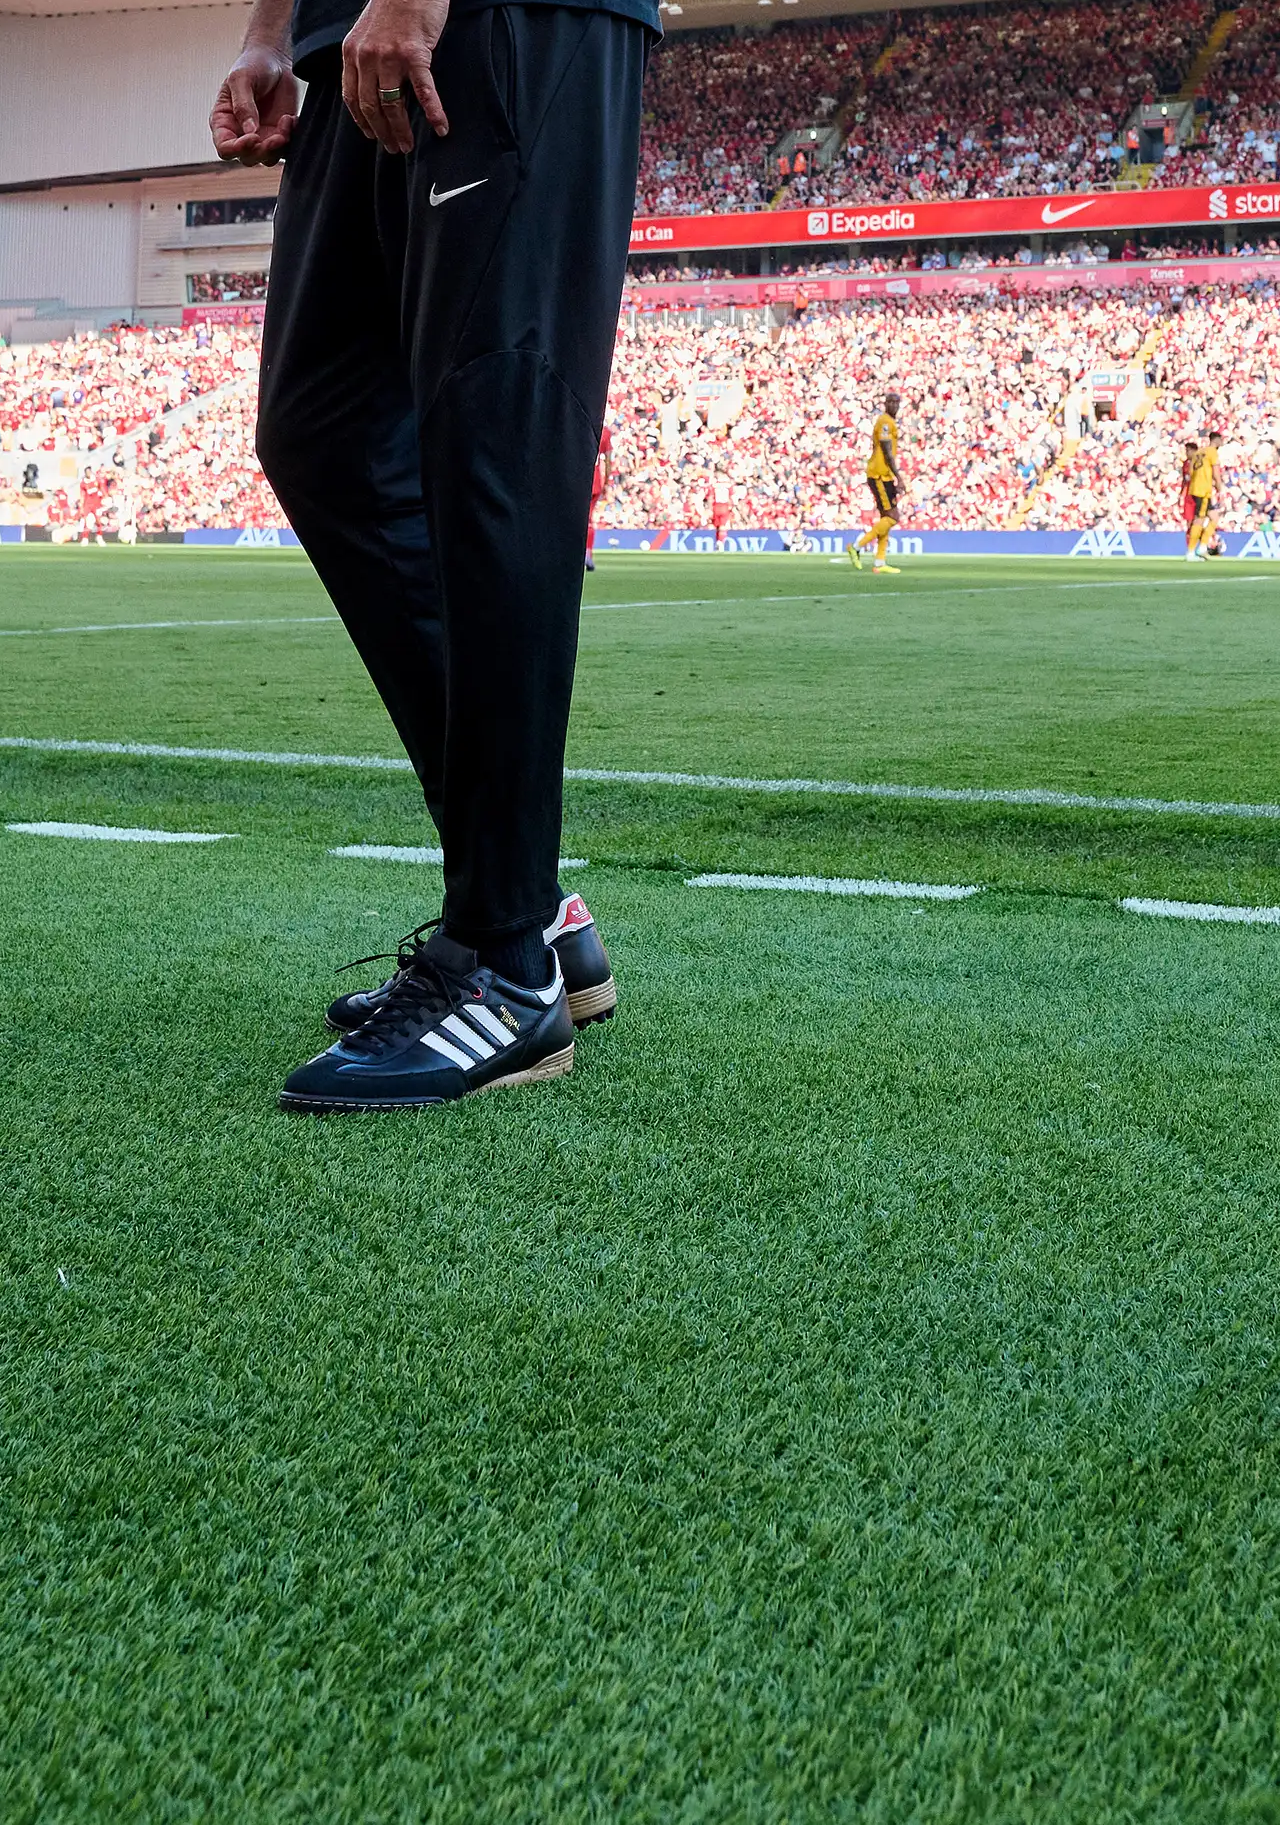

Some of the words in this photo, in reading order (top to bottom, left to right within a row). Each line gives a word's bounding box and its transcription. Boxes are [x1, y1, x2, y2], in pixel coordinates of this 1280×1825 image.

[645, 225, 673, 241] Can
[831, 209, 915, 235] Expedia
[235, 527, 281, 547] AXA
[669, 531, 768, 553] Know
[1068, 530, 1136, 557] AXA
